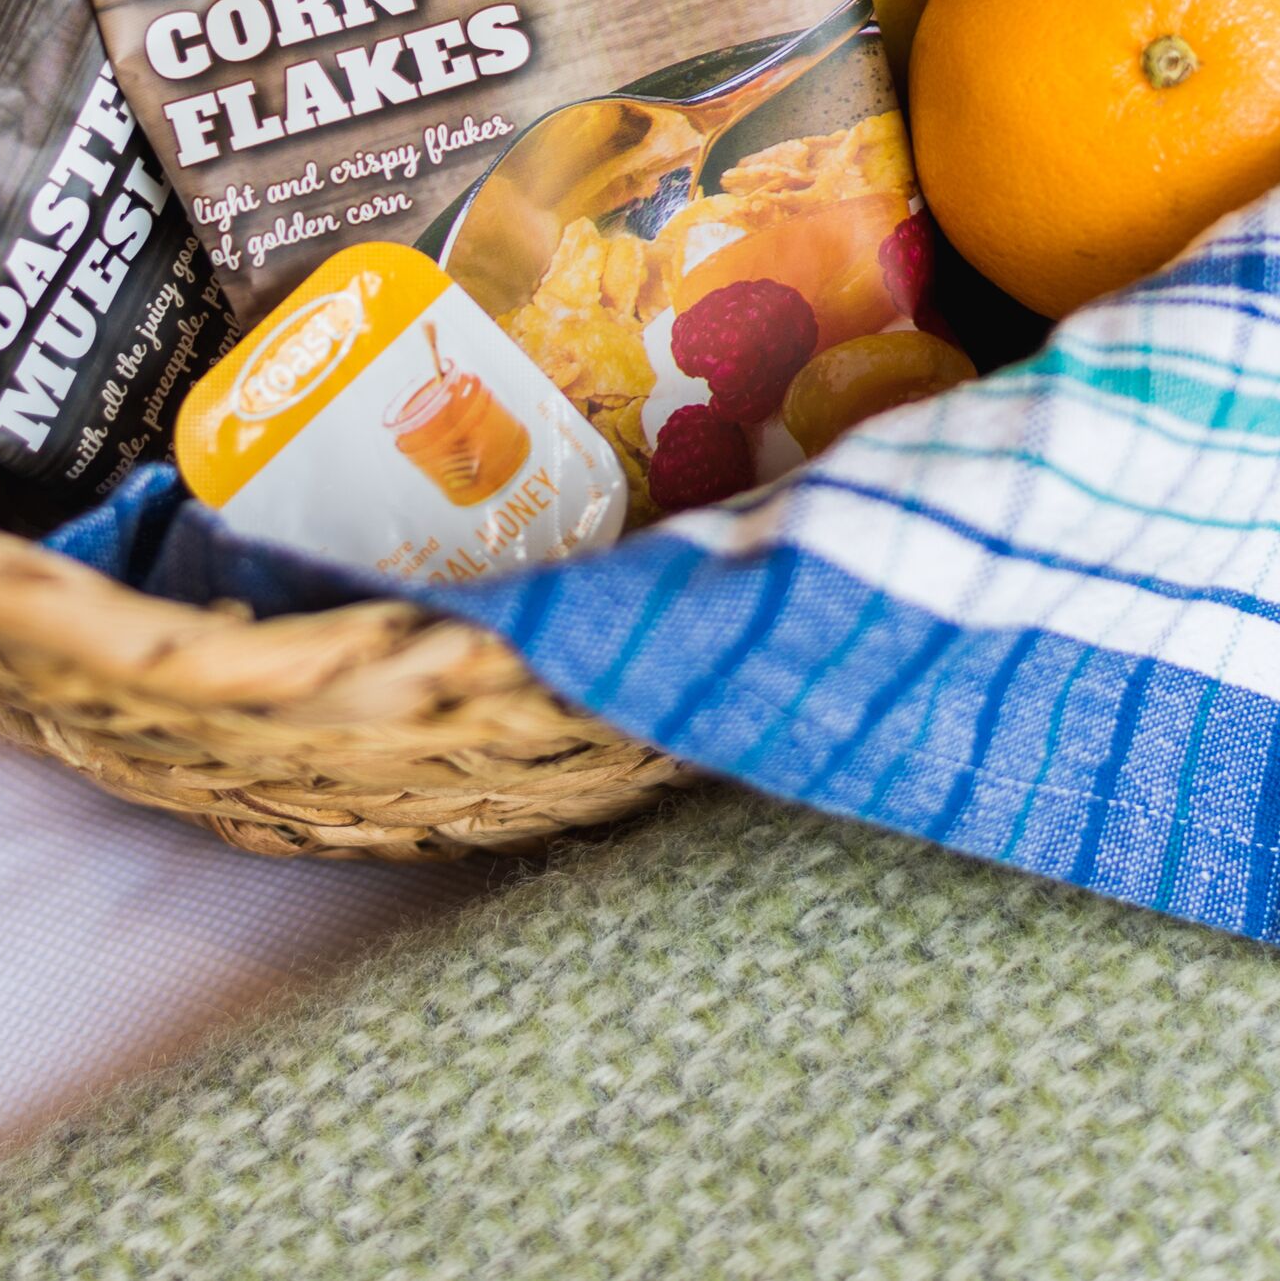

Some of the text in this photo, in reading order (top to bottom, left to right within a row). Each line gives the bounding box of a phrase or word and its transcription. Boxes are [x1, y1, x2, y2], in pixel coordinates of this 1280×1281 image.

[162, 3, 531, 171] FLAKES
[192, 115, 515, 231] light and crispy flakes
[210, 191, 413, 271] of golden corn
[66, 425, 108, 479] with
[101, 379, 128, 421] all
[116, 342, 147, 380] the
[135, 282, 185, 351] juicy
[376, 540, 415, 576] Pure
[475, 467, 561, 557] HONEY
